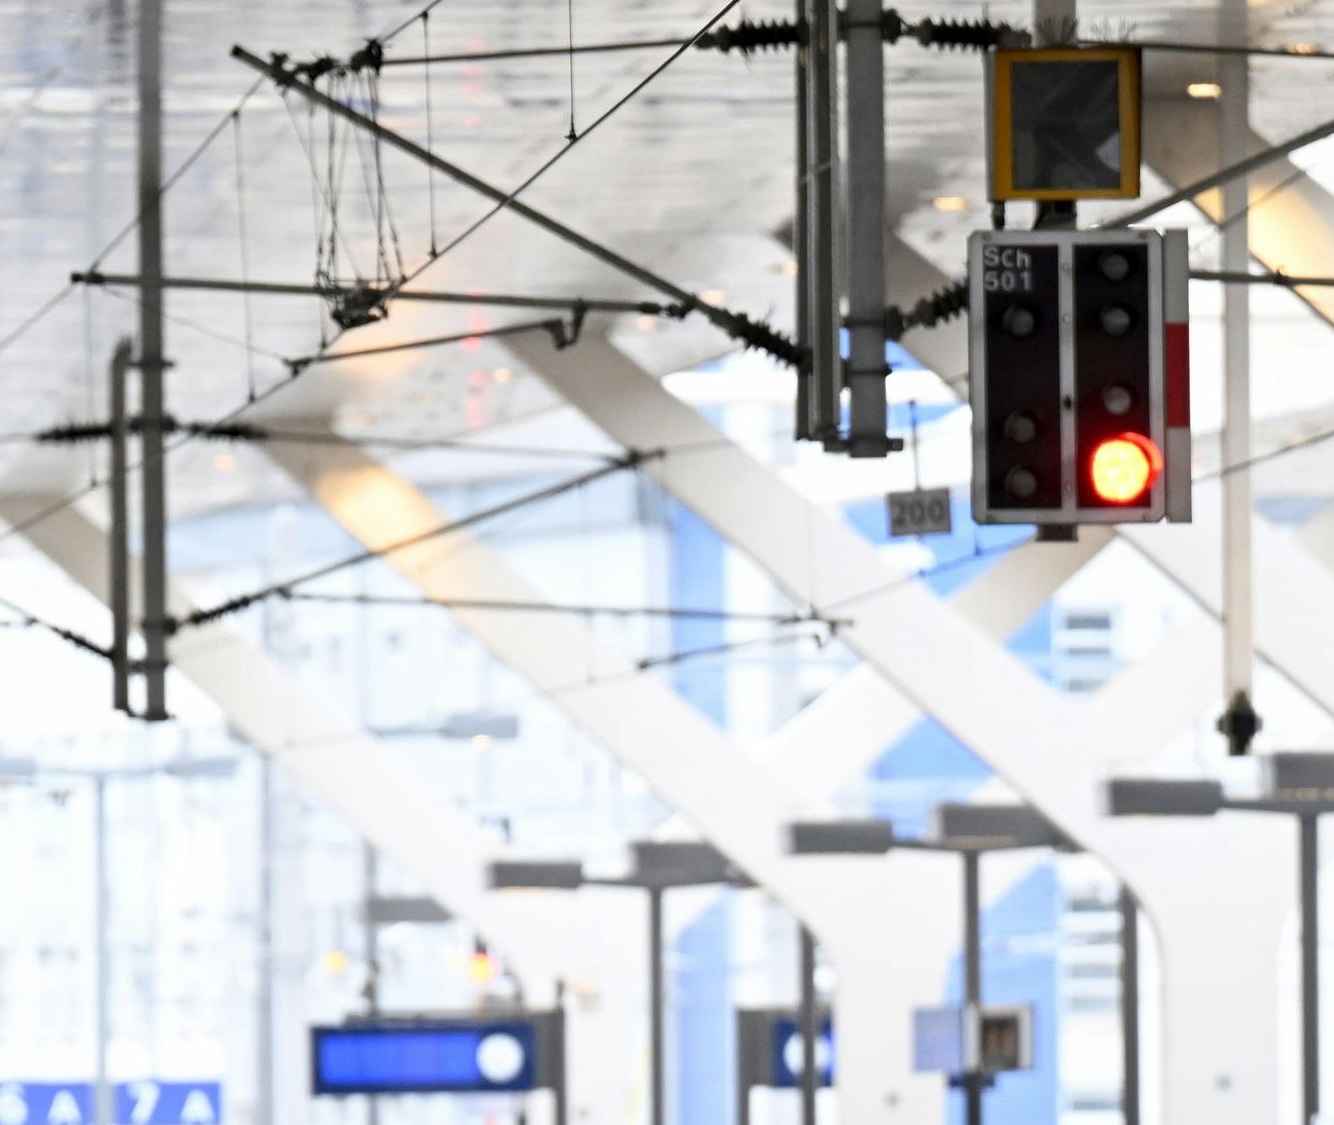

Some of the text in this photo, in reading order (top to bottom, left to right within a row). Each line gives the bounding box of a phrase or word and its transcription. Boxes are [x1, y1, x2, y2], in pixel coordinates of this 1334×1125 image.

[984, 270, 1031, 292] 501
[893, 497, 945, 527] 200
[47, 1090, 82, 1125] A
[127, 1080, 215, 1125] 7 A
